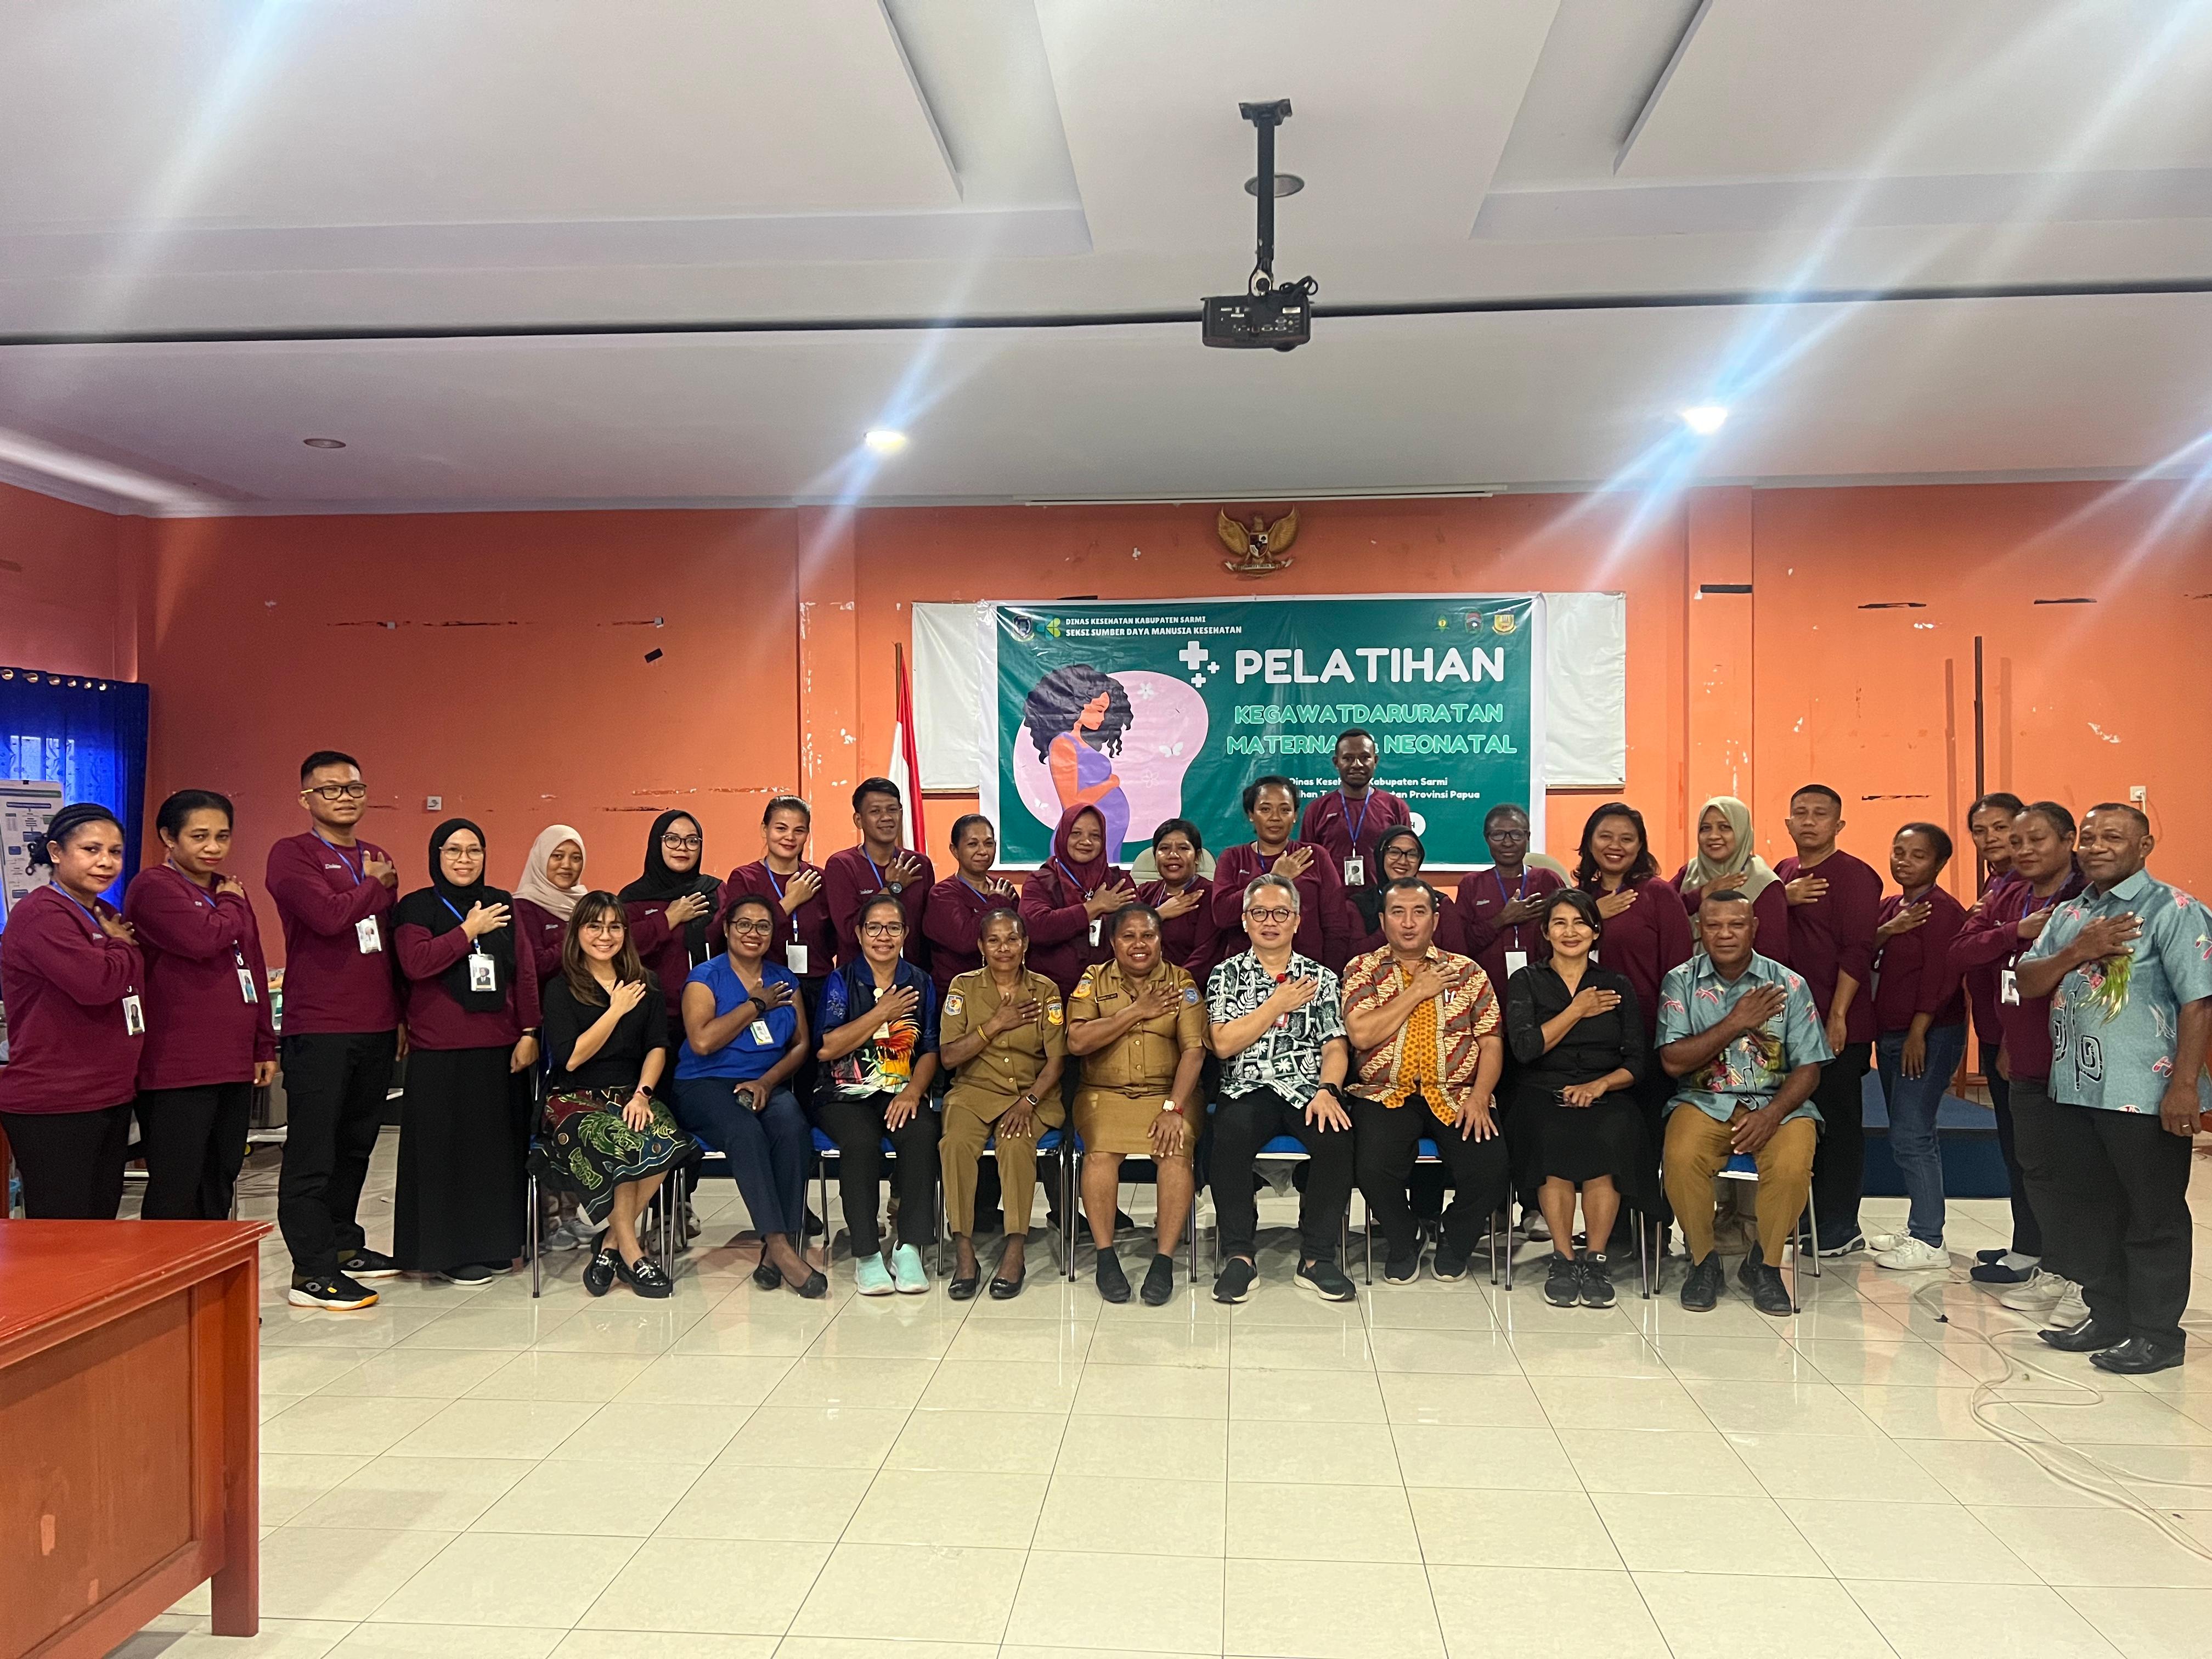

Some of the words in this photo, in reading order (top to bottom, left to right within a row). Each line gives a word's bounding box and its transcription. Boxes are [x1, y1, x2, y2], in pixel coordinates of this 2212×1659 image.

[1091, 628, 1125, 636] SUMBER
[1151, 627, 1192, 635] MANUSIA
[1193, 626, 1242, 634] KESEHATAN
[1235, 647, 1504, 684] PELATIHAN
[1234, 703, 1504, 725] KEGAWATDARURATAN
[1227, 734, 1338, 754] MATERNA
[1384, 733, 1517, 754] NEONATAL
[1420, 777, 1448, 786] Sarmi
[1409, 790, 1448, 798] Provinsi
[1450, 790, 1480, 800] Papua
